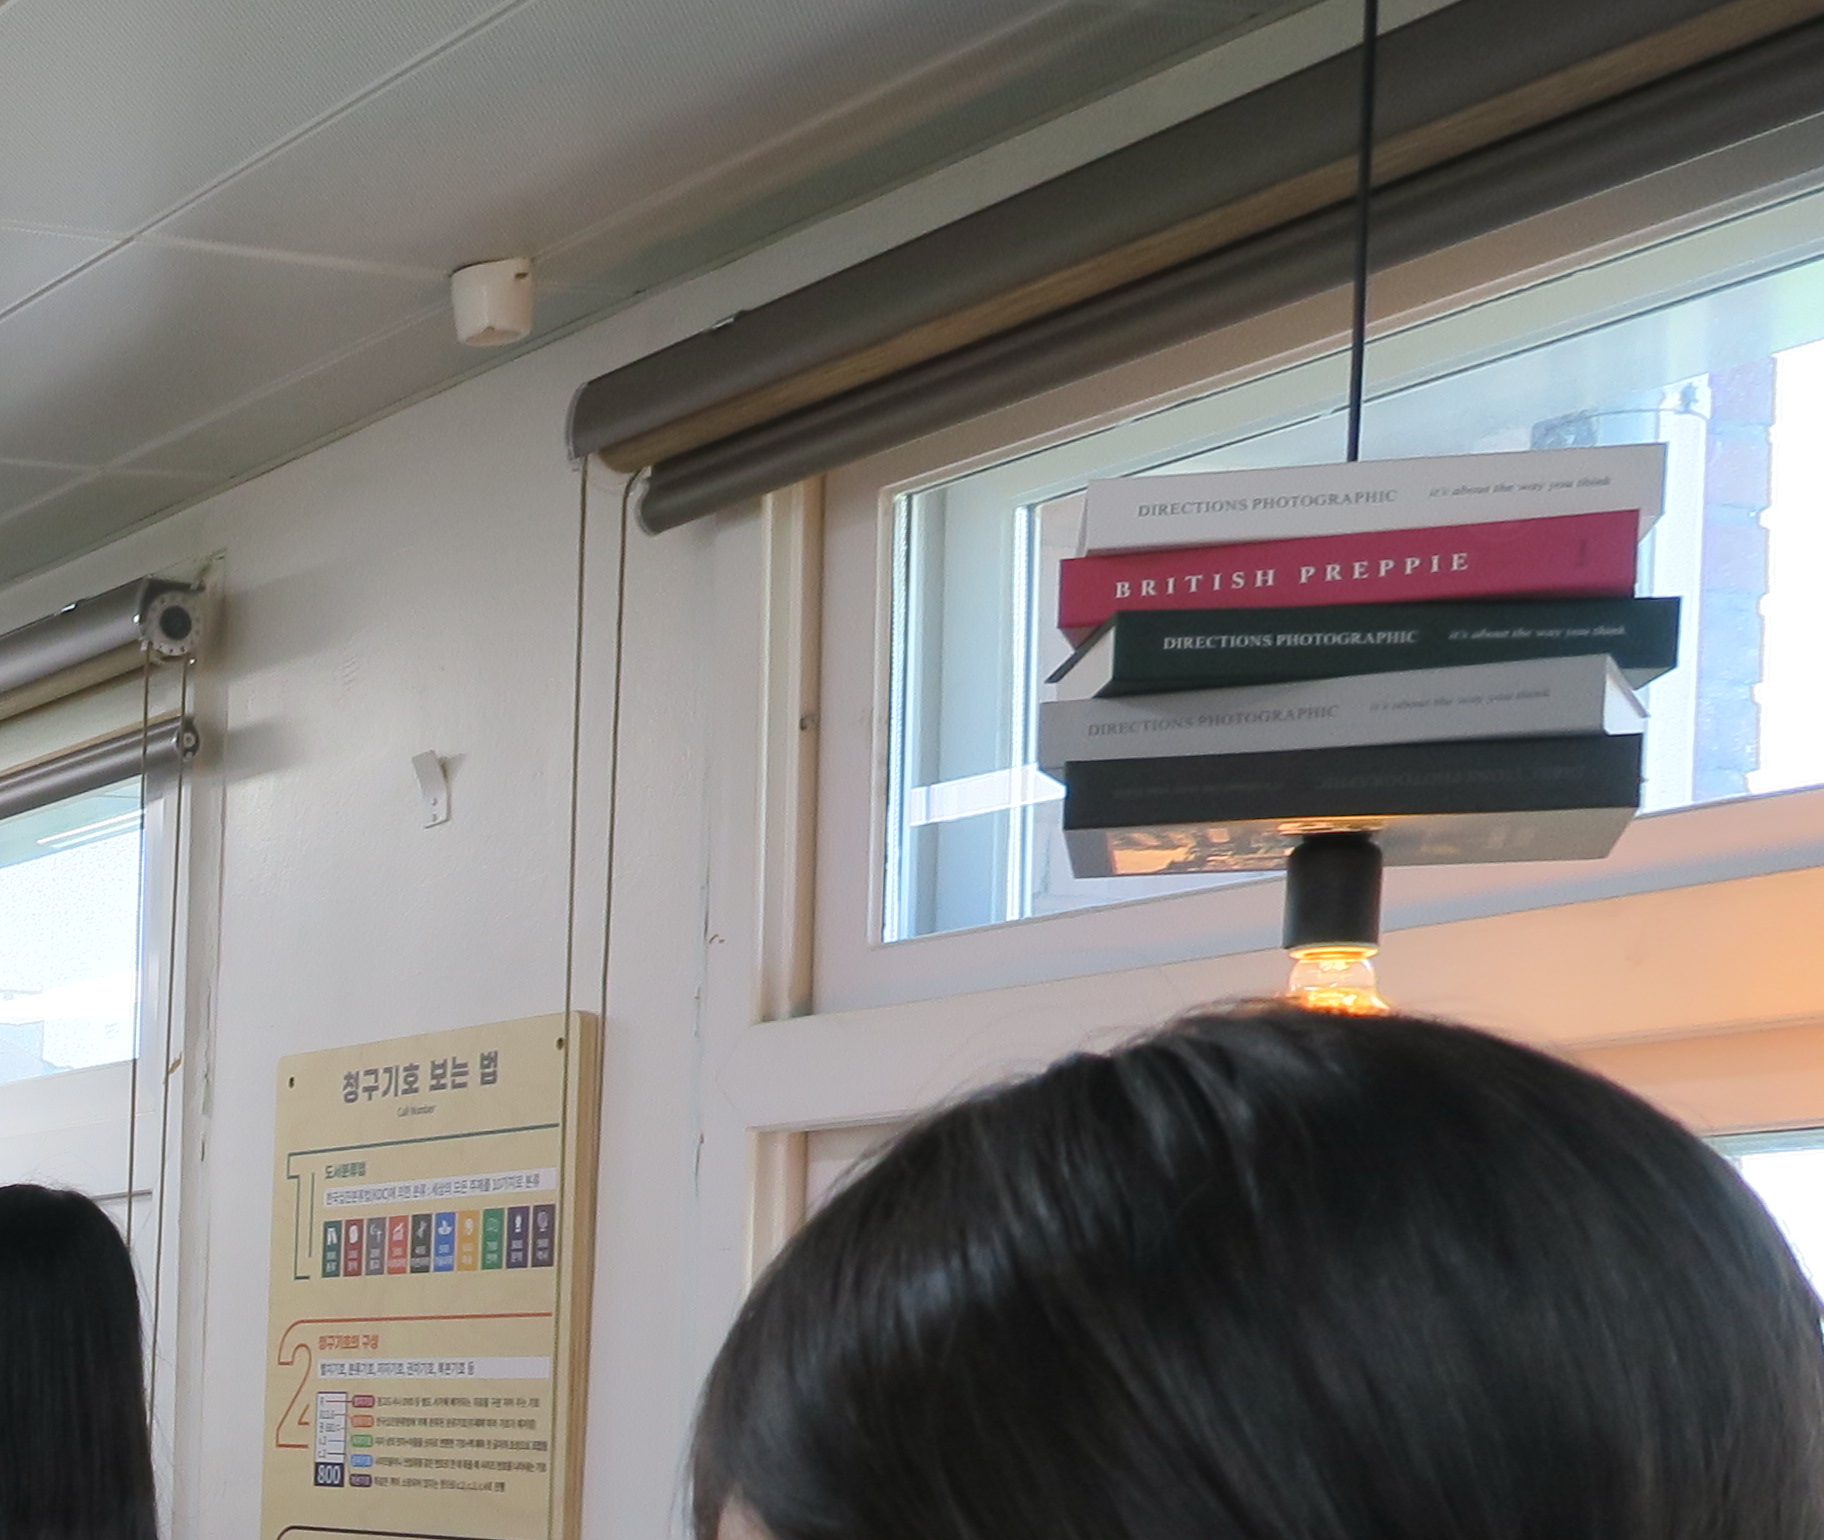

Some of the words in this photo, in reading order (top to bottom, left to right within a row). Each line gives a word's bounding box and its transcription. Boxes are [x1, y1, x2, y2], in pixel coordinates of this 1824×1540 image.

[1137, 498, 1248, 518] DIRECTIONS
[1251, 489, 1398, 512] PHOTOGRAPHIC
[1452, 484, 1490, 496] about
[1491, 483, 1515, 494] the
[1115, 569, 1276, 599] BRITISH
[1299, 552, 1469, 584] PREPPIE
[1163, 633, 1272, 650] DIRECTIONS
[1274, 630, 1419, 647] PHOTOGRAPHIC
[1088, 718, 1193, 737] DIRECTIONS
[1198, 704, 1339, 728] PHOTOGRAPHIC
[342, 1062, 420, 1103] 청구기호
[429, 1055, 470, 1093] 보는
[479, 1050, 499, 1086] 법
[317, 1465, 341, 1484] 800
